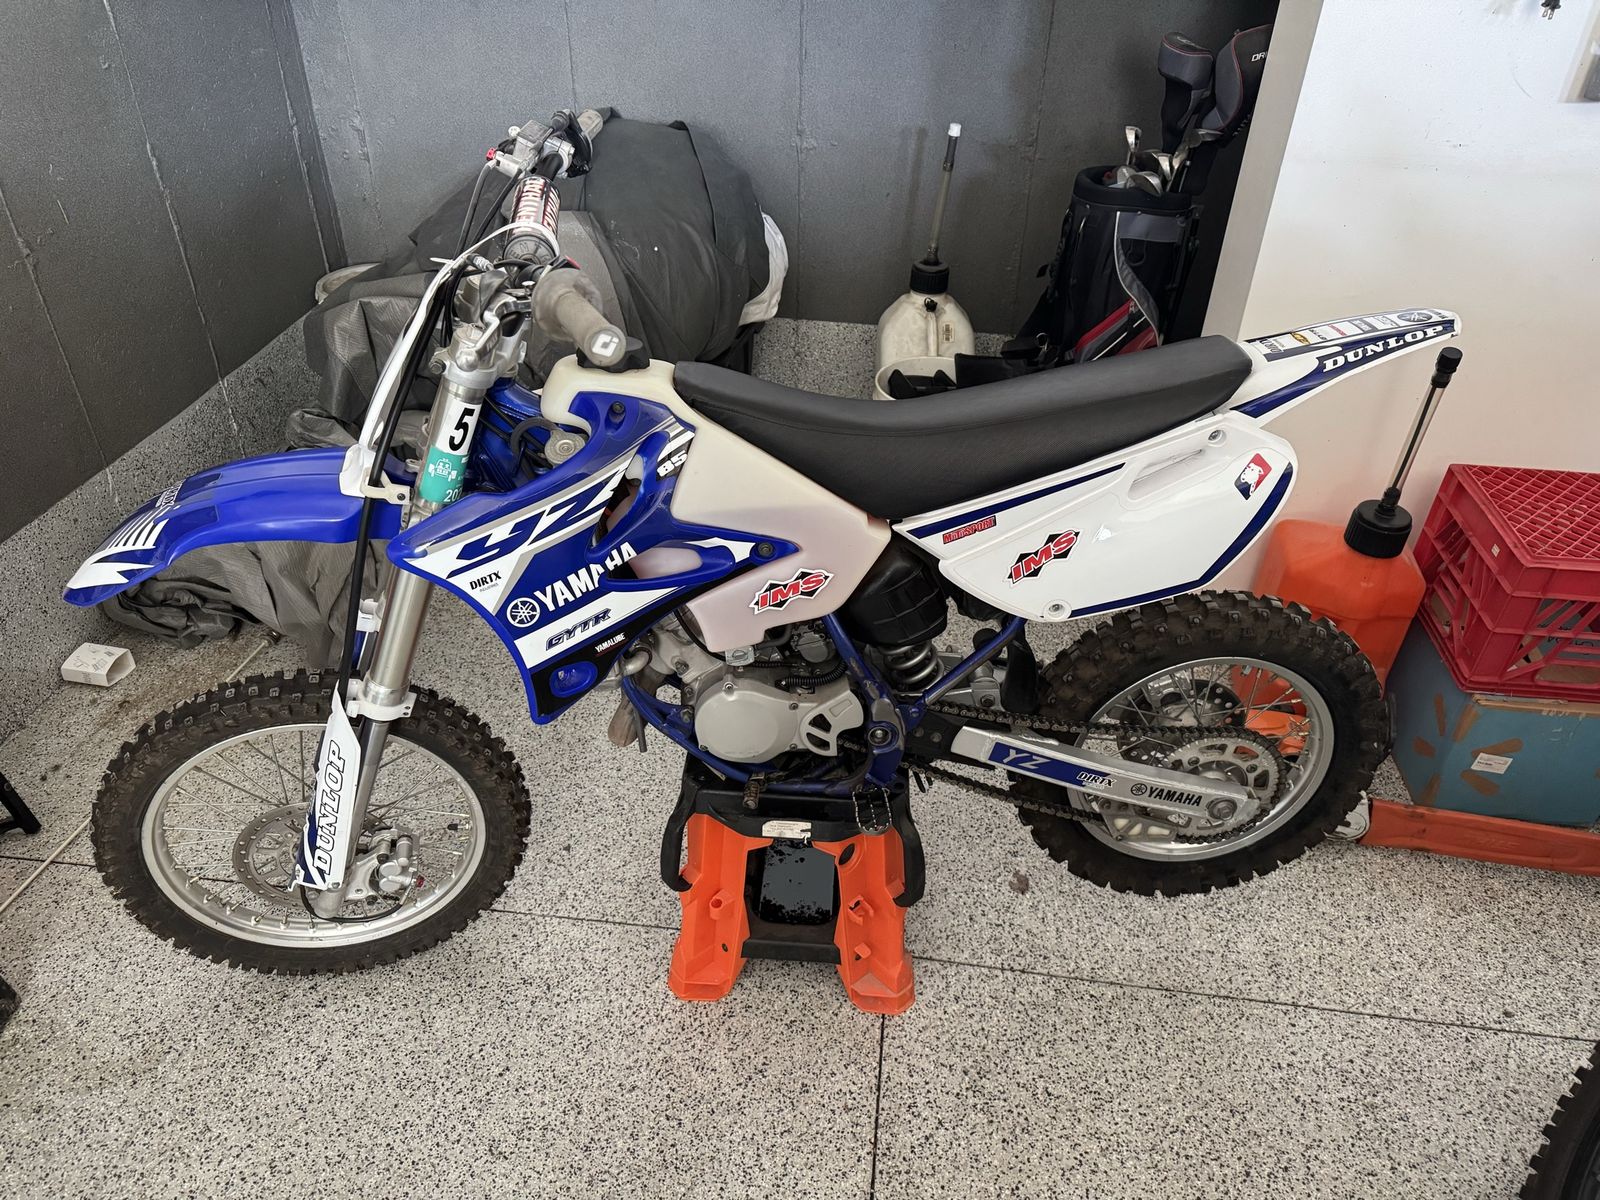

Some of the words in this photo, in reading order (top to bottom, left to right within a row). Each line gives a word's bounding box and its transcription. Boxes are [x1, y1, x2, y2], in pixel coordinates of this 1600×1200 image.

[1251, 51, 1267, 61] DR
[1323, 326, 1443, 372] DUNLOP
[449, 408, 476, 452] 5
[657, 450, 688, 477] 85
[447, 466, 622, 578] YZ
[1011, 530, 1077, 584] IMS
[469, 570, 502, 590] DIRTX
[533, 541, 638, 612] YAMAHA
[758, 572, 826, 610] IMS
[546, 607, 611, 651] GYTR
[594, 632, 626, 653] YAMALUBE
[1003, 749, 1051, 769] YZ
[1077, 771, 1116, 788] DIRTX
[1148, 786, 1203, 807] YAMAHA
[312, 739, 346, 876] DUNLOP
